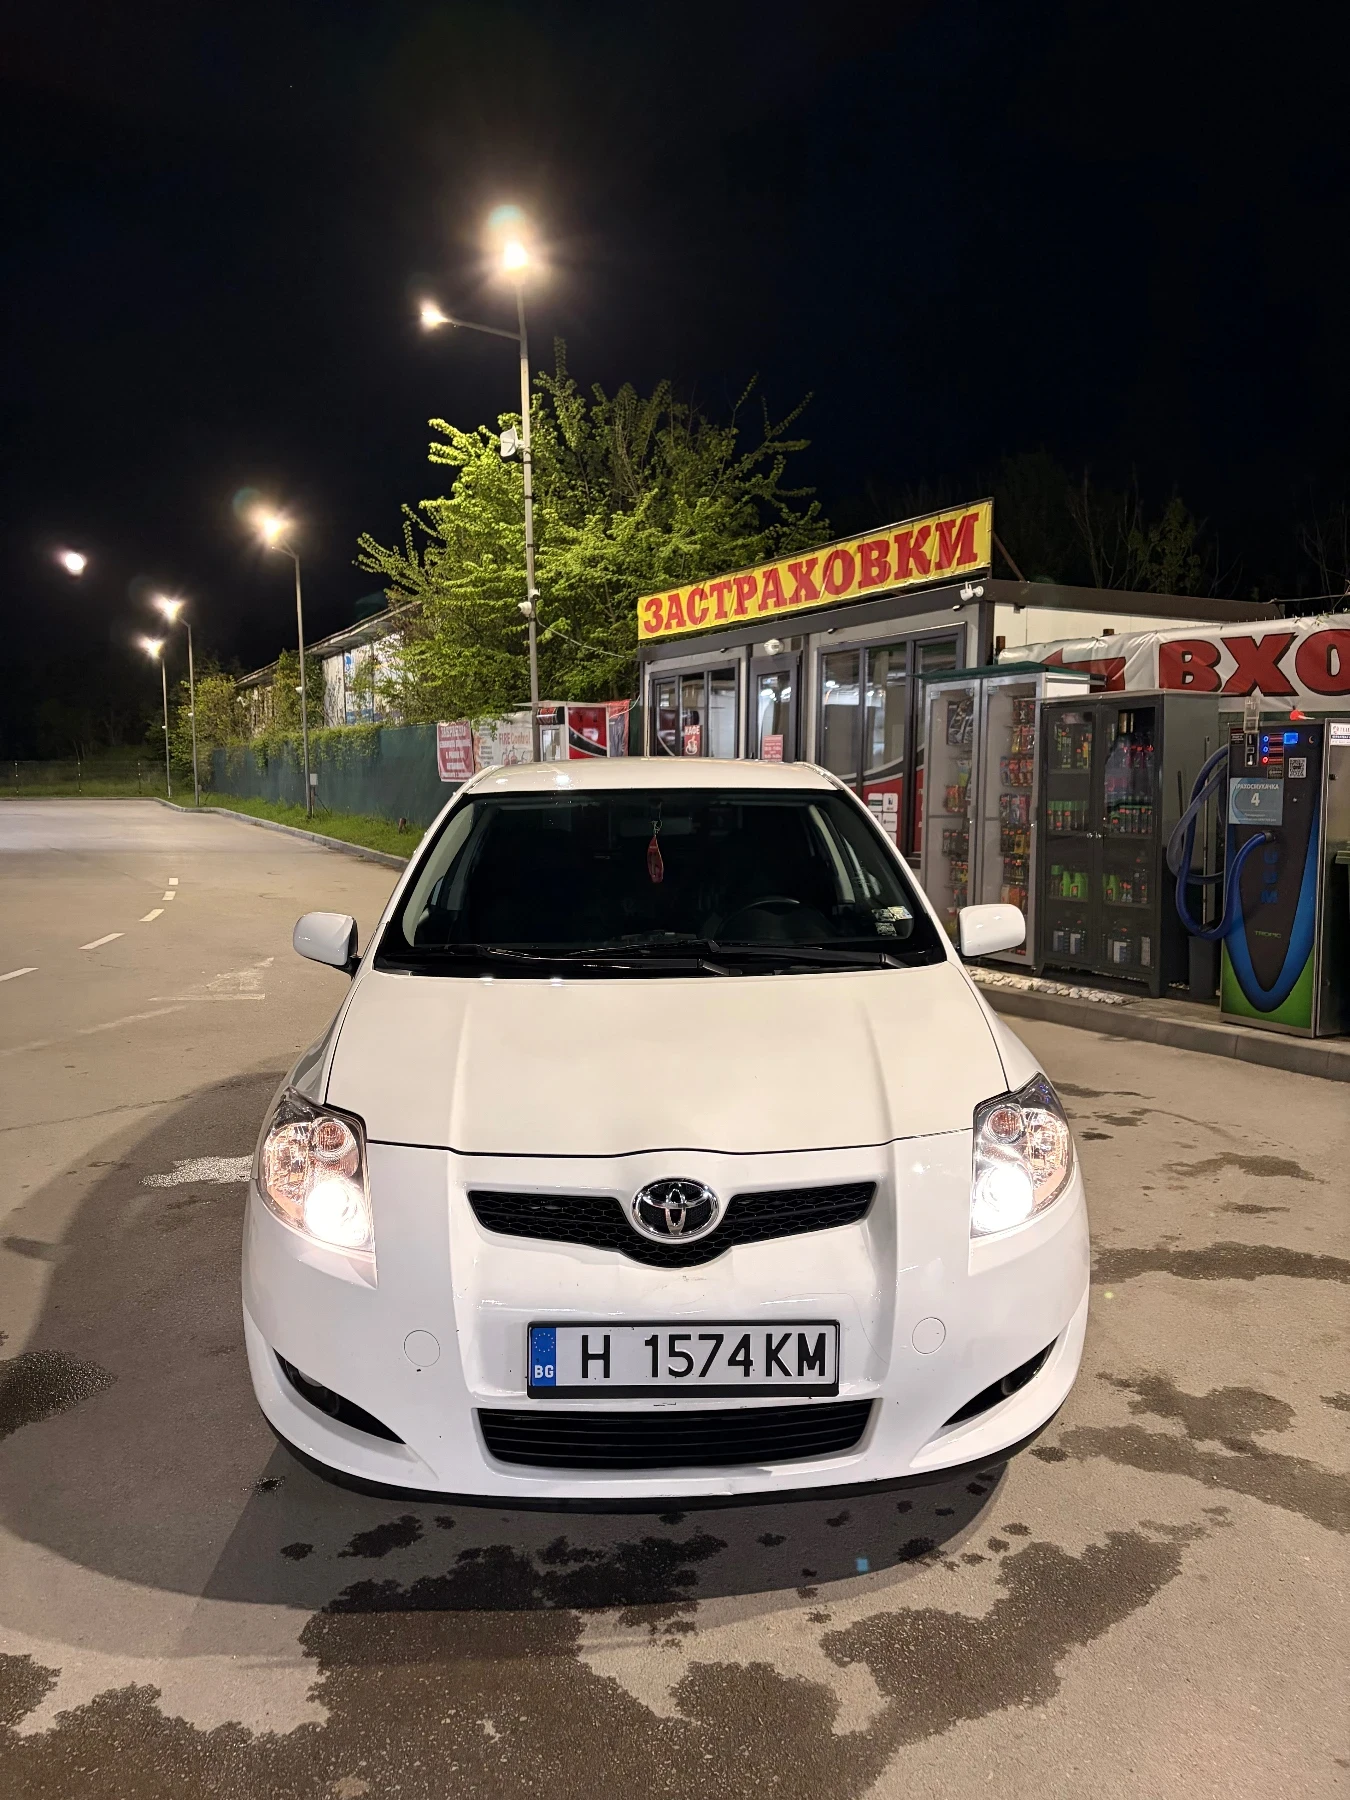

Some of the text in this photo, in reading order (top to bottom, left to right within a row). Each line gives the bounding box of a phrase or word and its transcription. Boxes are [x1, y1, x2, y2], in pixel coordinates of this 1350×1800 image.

[644, 512, 979, 634] ЗАСТРАХОВКИ
[684, 725, 701, 735] КАФЕ
[498, 732, 511, 745] FIRE
[511, 731, 531, 745] Control
[1250, 792, 1261, 807] 4
[581, 1334, 611, 1379] H
[534, 1364, 554, 1379] BG
